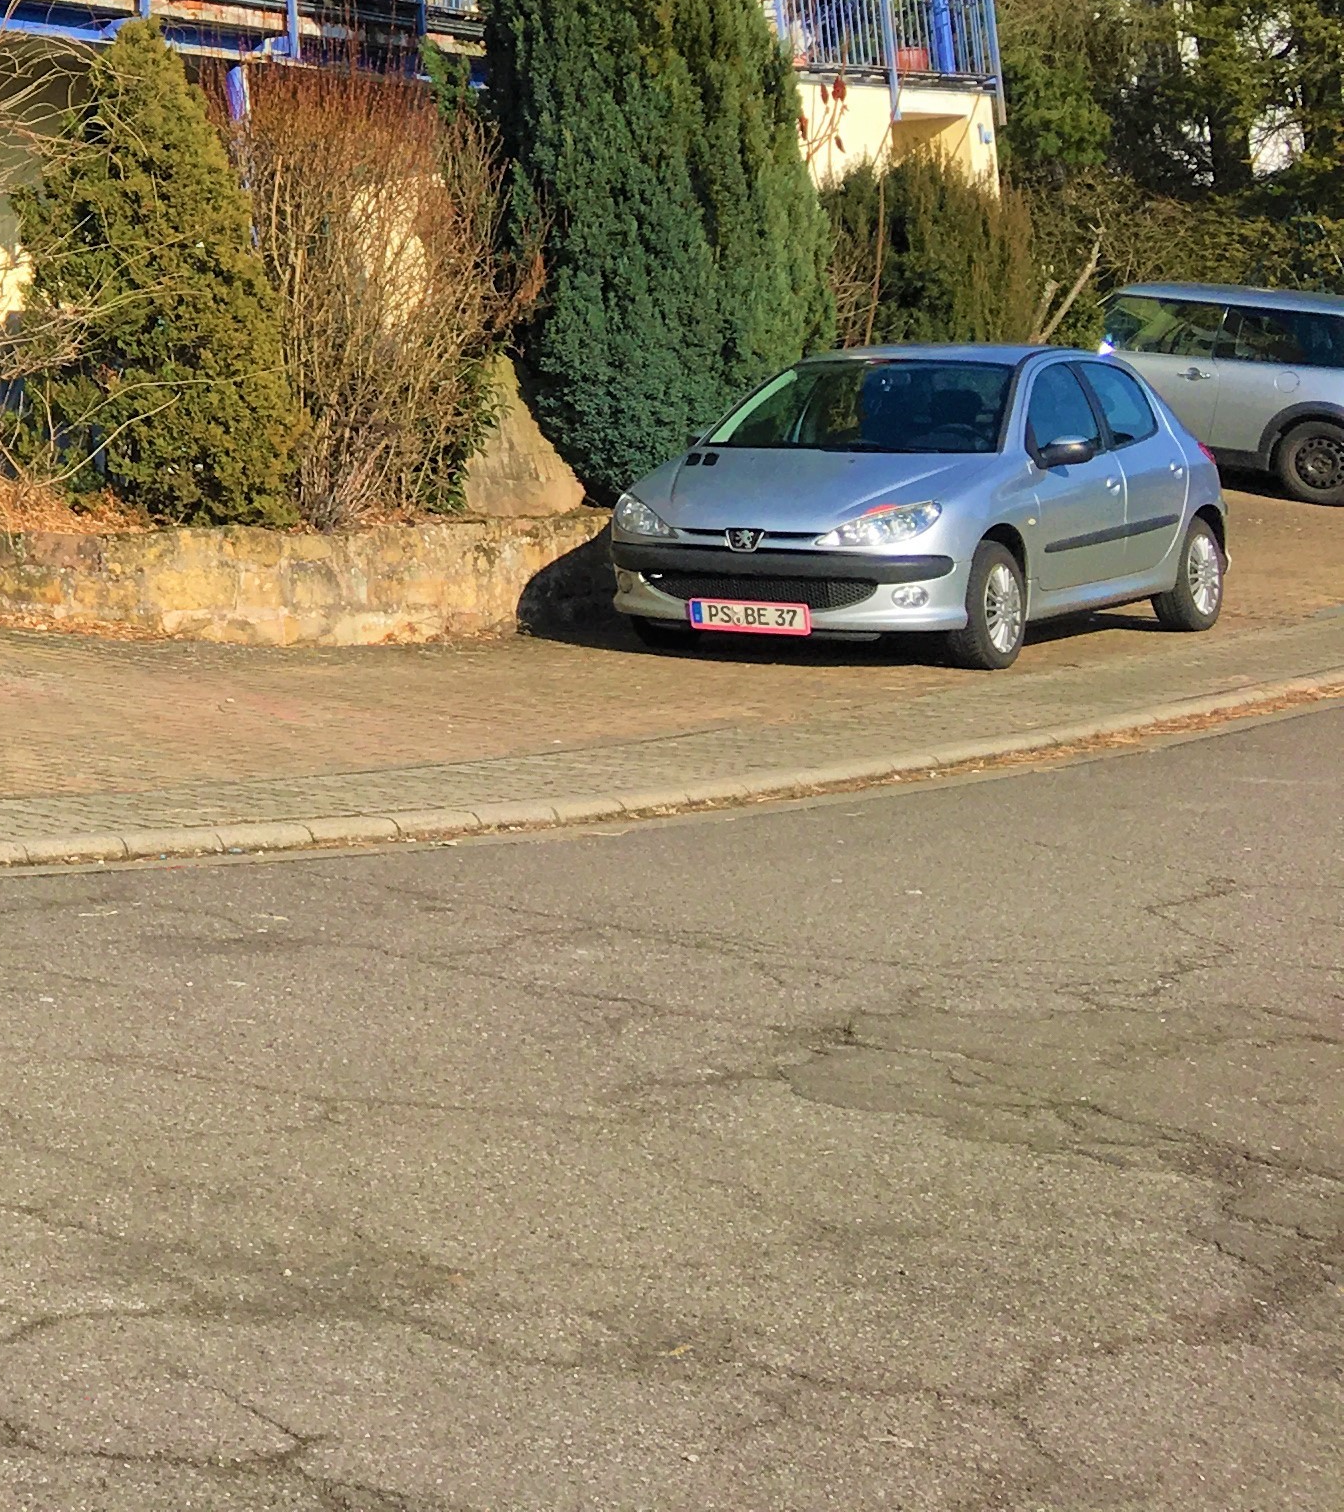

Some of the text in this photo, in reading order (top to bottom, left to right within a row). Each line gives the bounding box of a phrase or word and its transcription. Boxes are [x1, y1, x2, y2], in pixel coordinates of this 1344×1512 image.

[707, 604, 798, 627] PS BE 37
